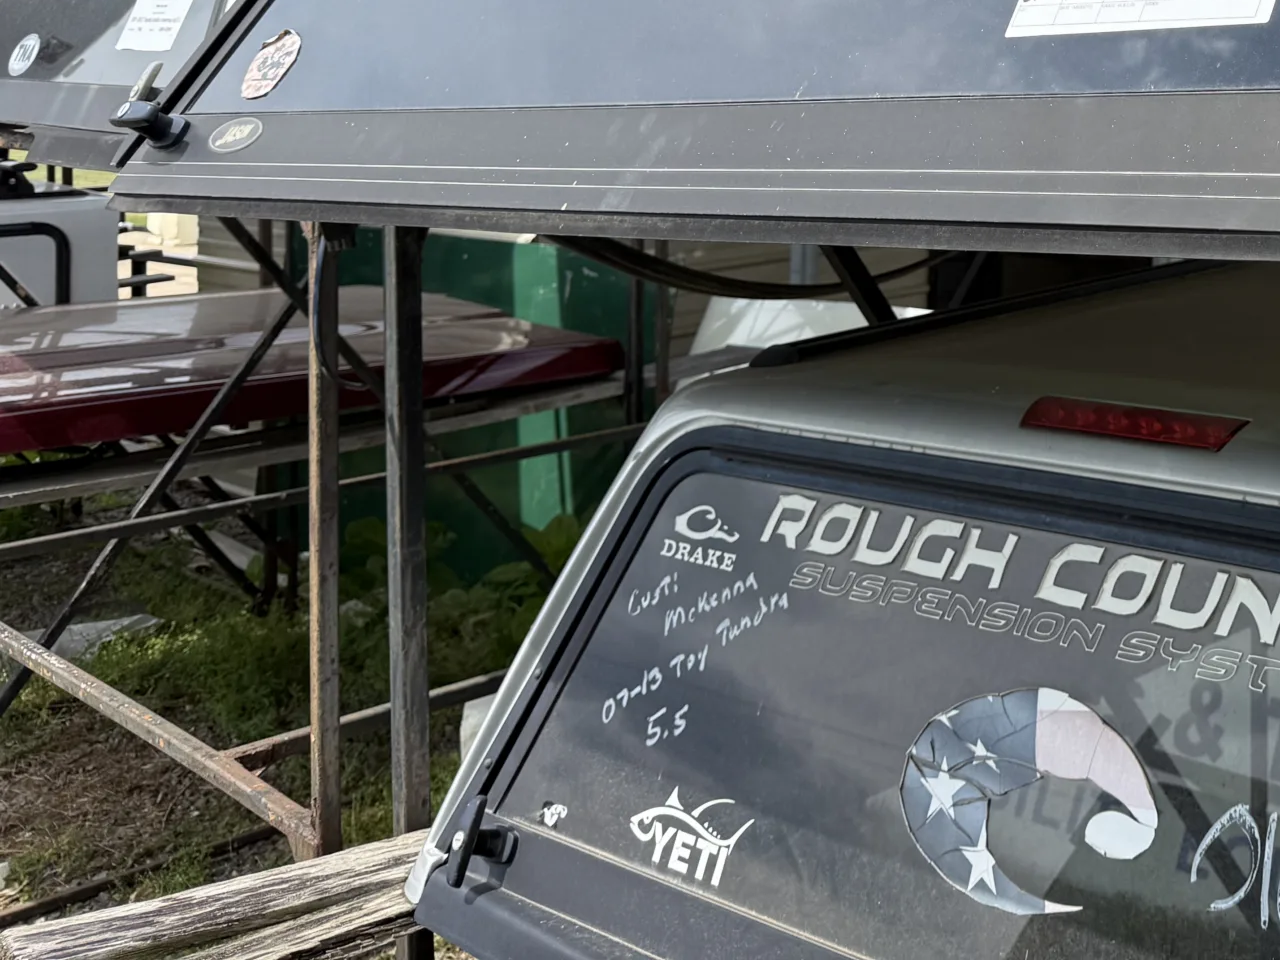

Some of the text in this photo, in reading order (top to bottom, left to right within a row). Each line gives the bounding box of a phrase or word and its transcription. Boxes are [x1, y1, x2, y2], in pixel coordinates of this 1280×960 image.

[660, 538, 737, 572] DRAKE
[759, 493, 1020, 590] ROUGH
[789, 561, 1105, 653] SUSPENSION
[601, 591, 790, 725] 07-13 Toy Tundra
[645, 704, 690, 747] 5.5
[650, 819, 730, 887] YETI
